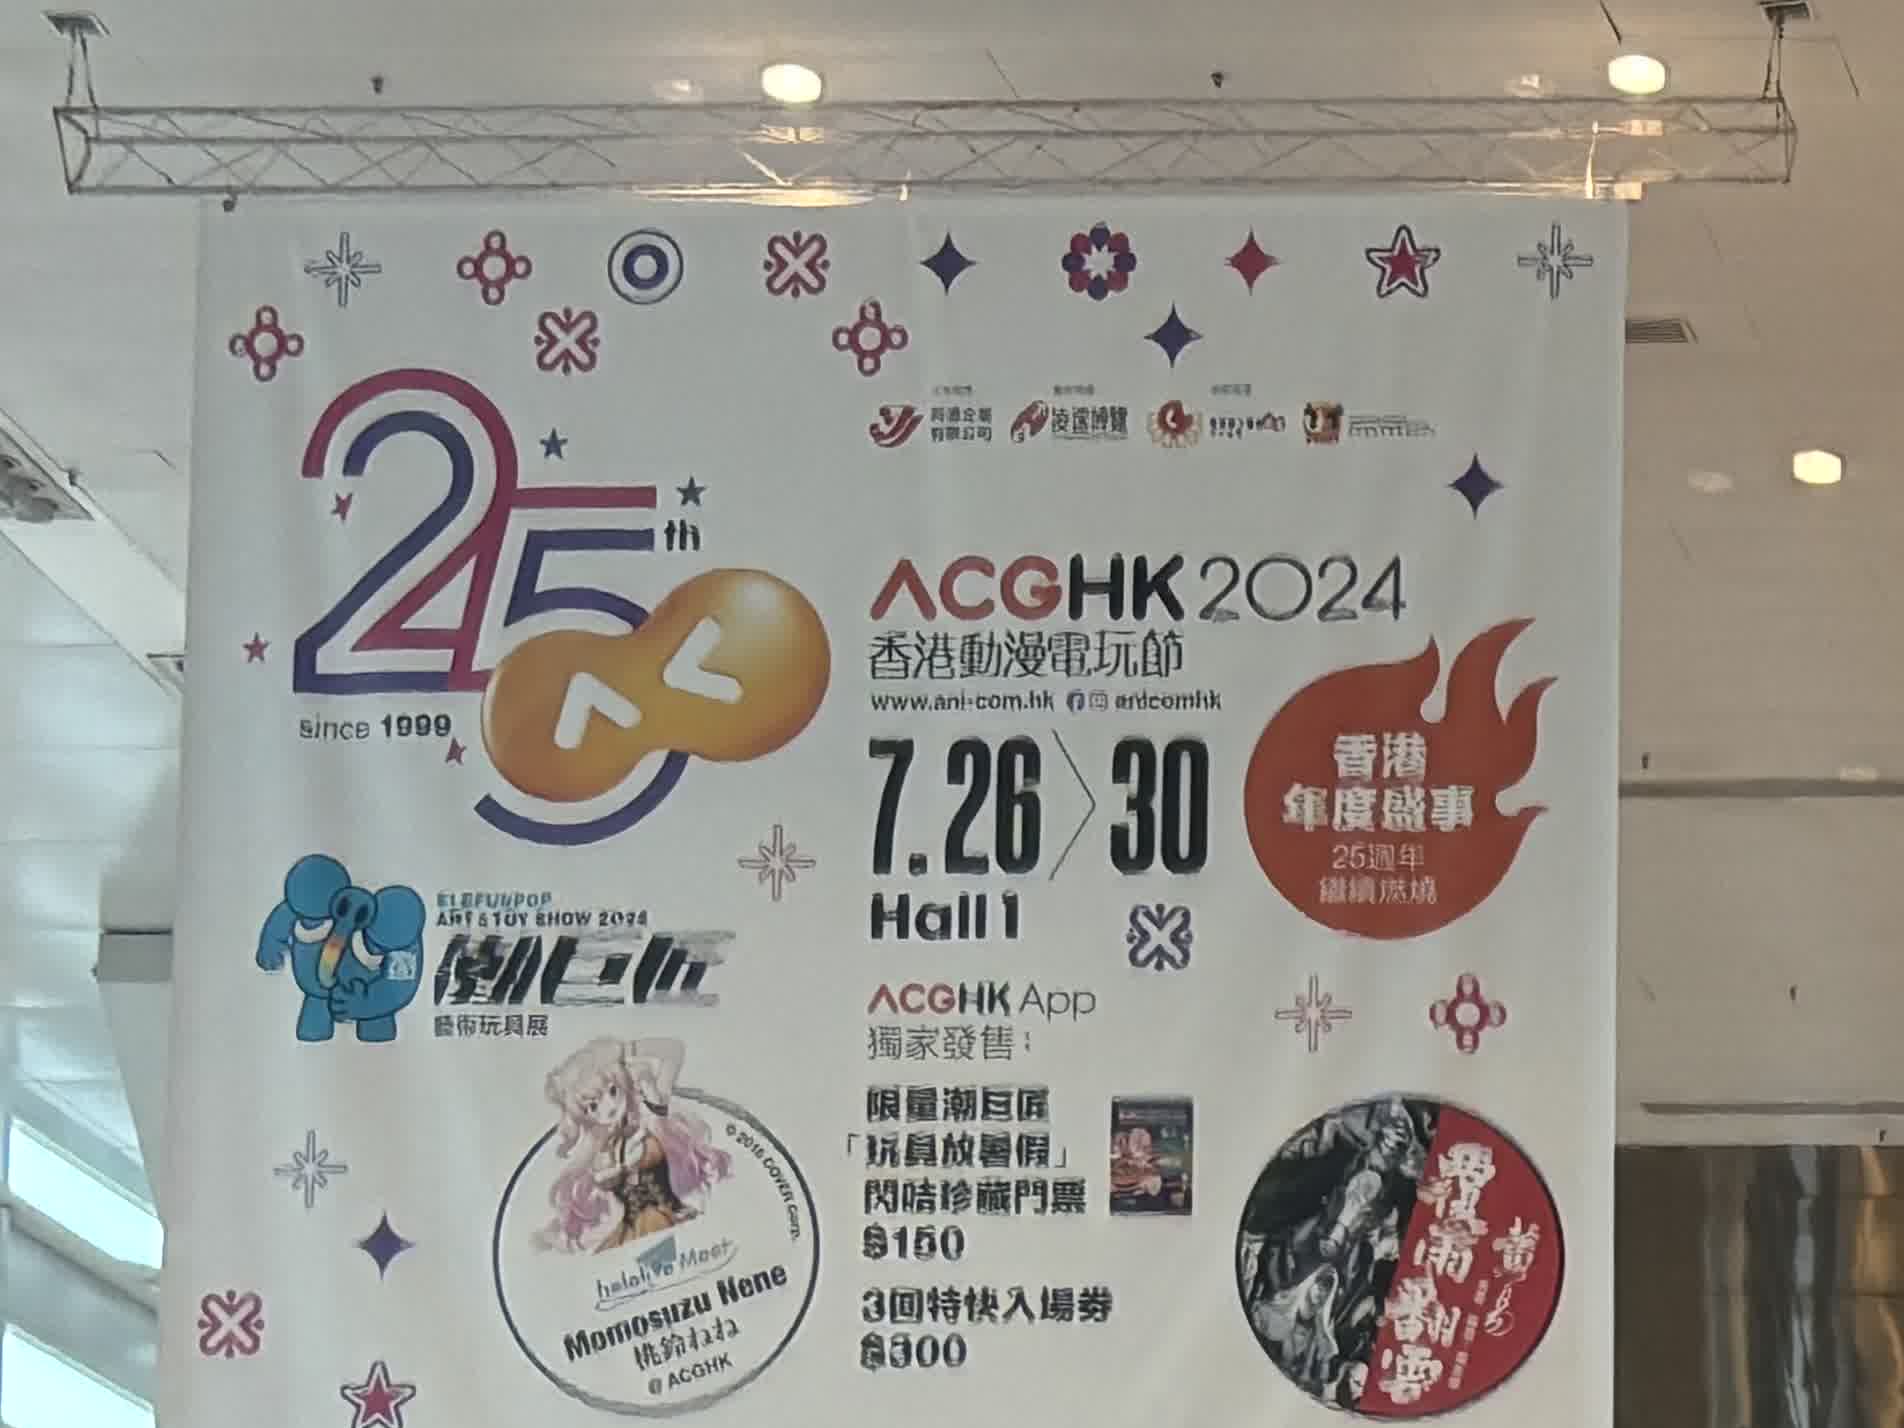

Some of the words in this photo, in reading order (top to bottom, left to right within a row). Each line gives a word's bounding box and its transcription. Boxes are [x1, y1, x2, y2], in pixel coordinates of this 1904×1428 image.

[869, 630, 1184, 679] 香港動漫電玩節
[870, 689, 1054, 712] www.ani-com.hk
[300, 714, 370, 739] since
[380, 713, 452, 738] 1999
[1334, 732, 1427, 781] 香港
[869, 734, 1041, 877] 7.26
[1111, 735, 1209, 878] 30
[1282, 783, 1475, 832] 年度盛事
[870, 891, 987, 941] Hall
[1001, 891, 1019, 940] 1
[867, 982, 1011, 1016] ACGHK
[1018, 983, 1096, 1017] App
[866, 1086, 1050, 1122] 限量潮巨匠
[563, 1291, 712, 1362] Momosuzu
[716, 1264, 788, 1306] Nene
